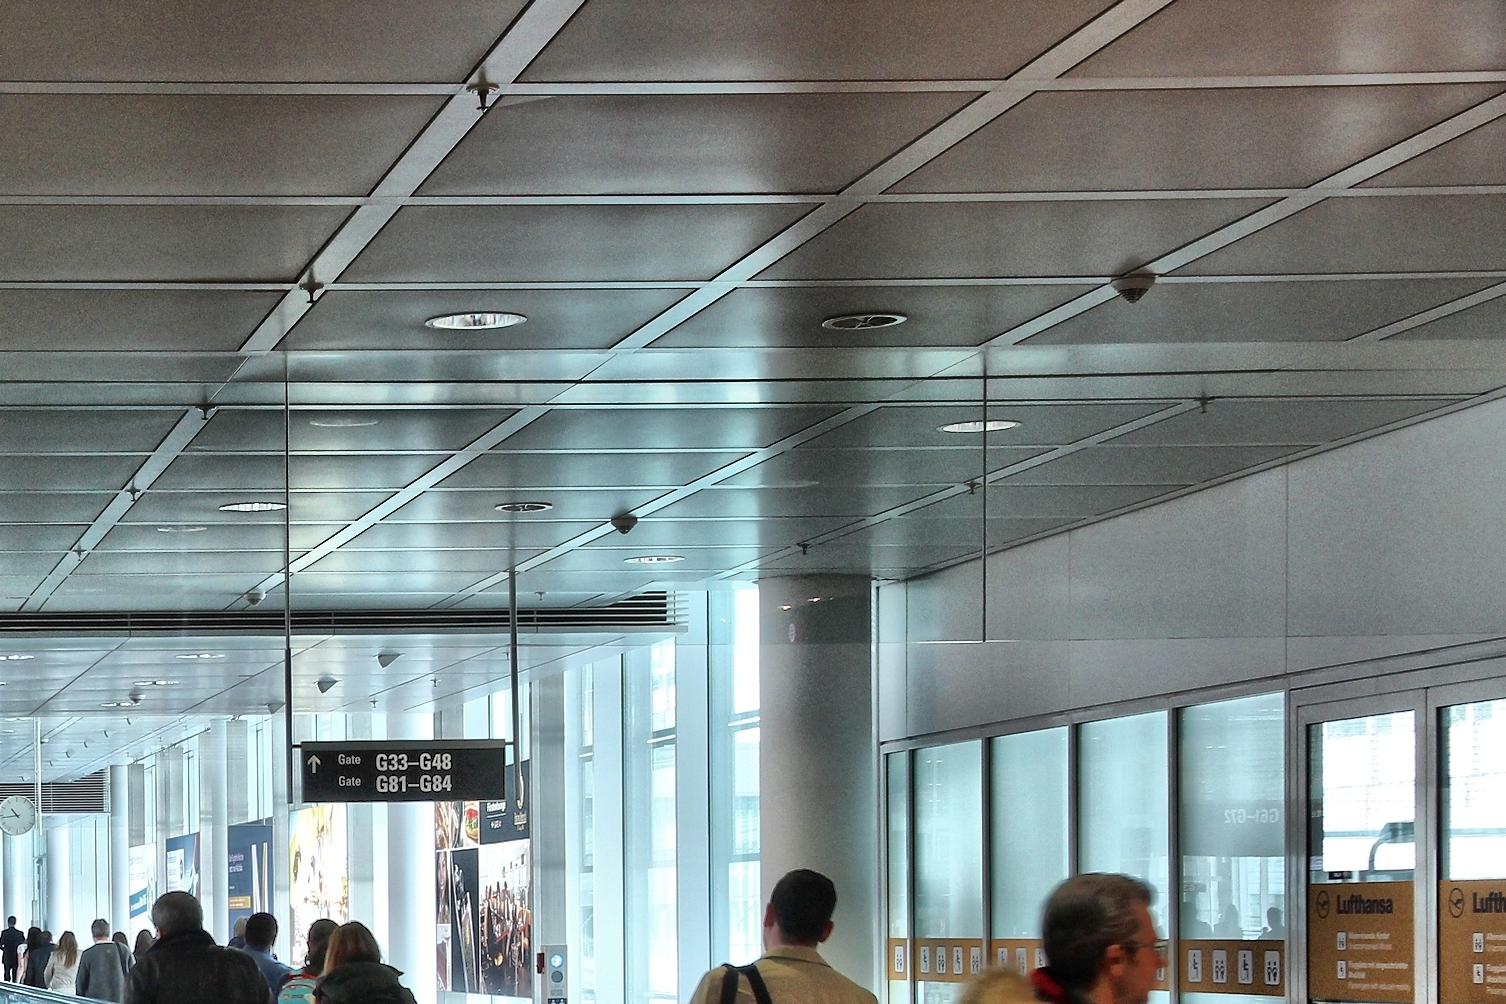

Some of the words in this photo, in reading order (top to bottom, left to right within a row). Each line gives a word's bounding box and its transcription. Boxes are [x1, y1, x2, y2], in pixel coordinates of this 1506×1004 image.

[338, 754, 361, 765] Gate
[338, 775, 362, 787] Gate
[1336, 894, 1393, 914] Lufthansa
